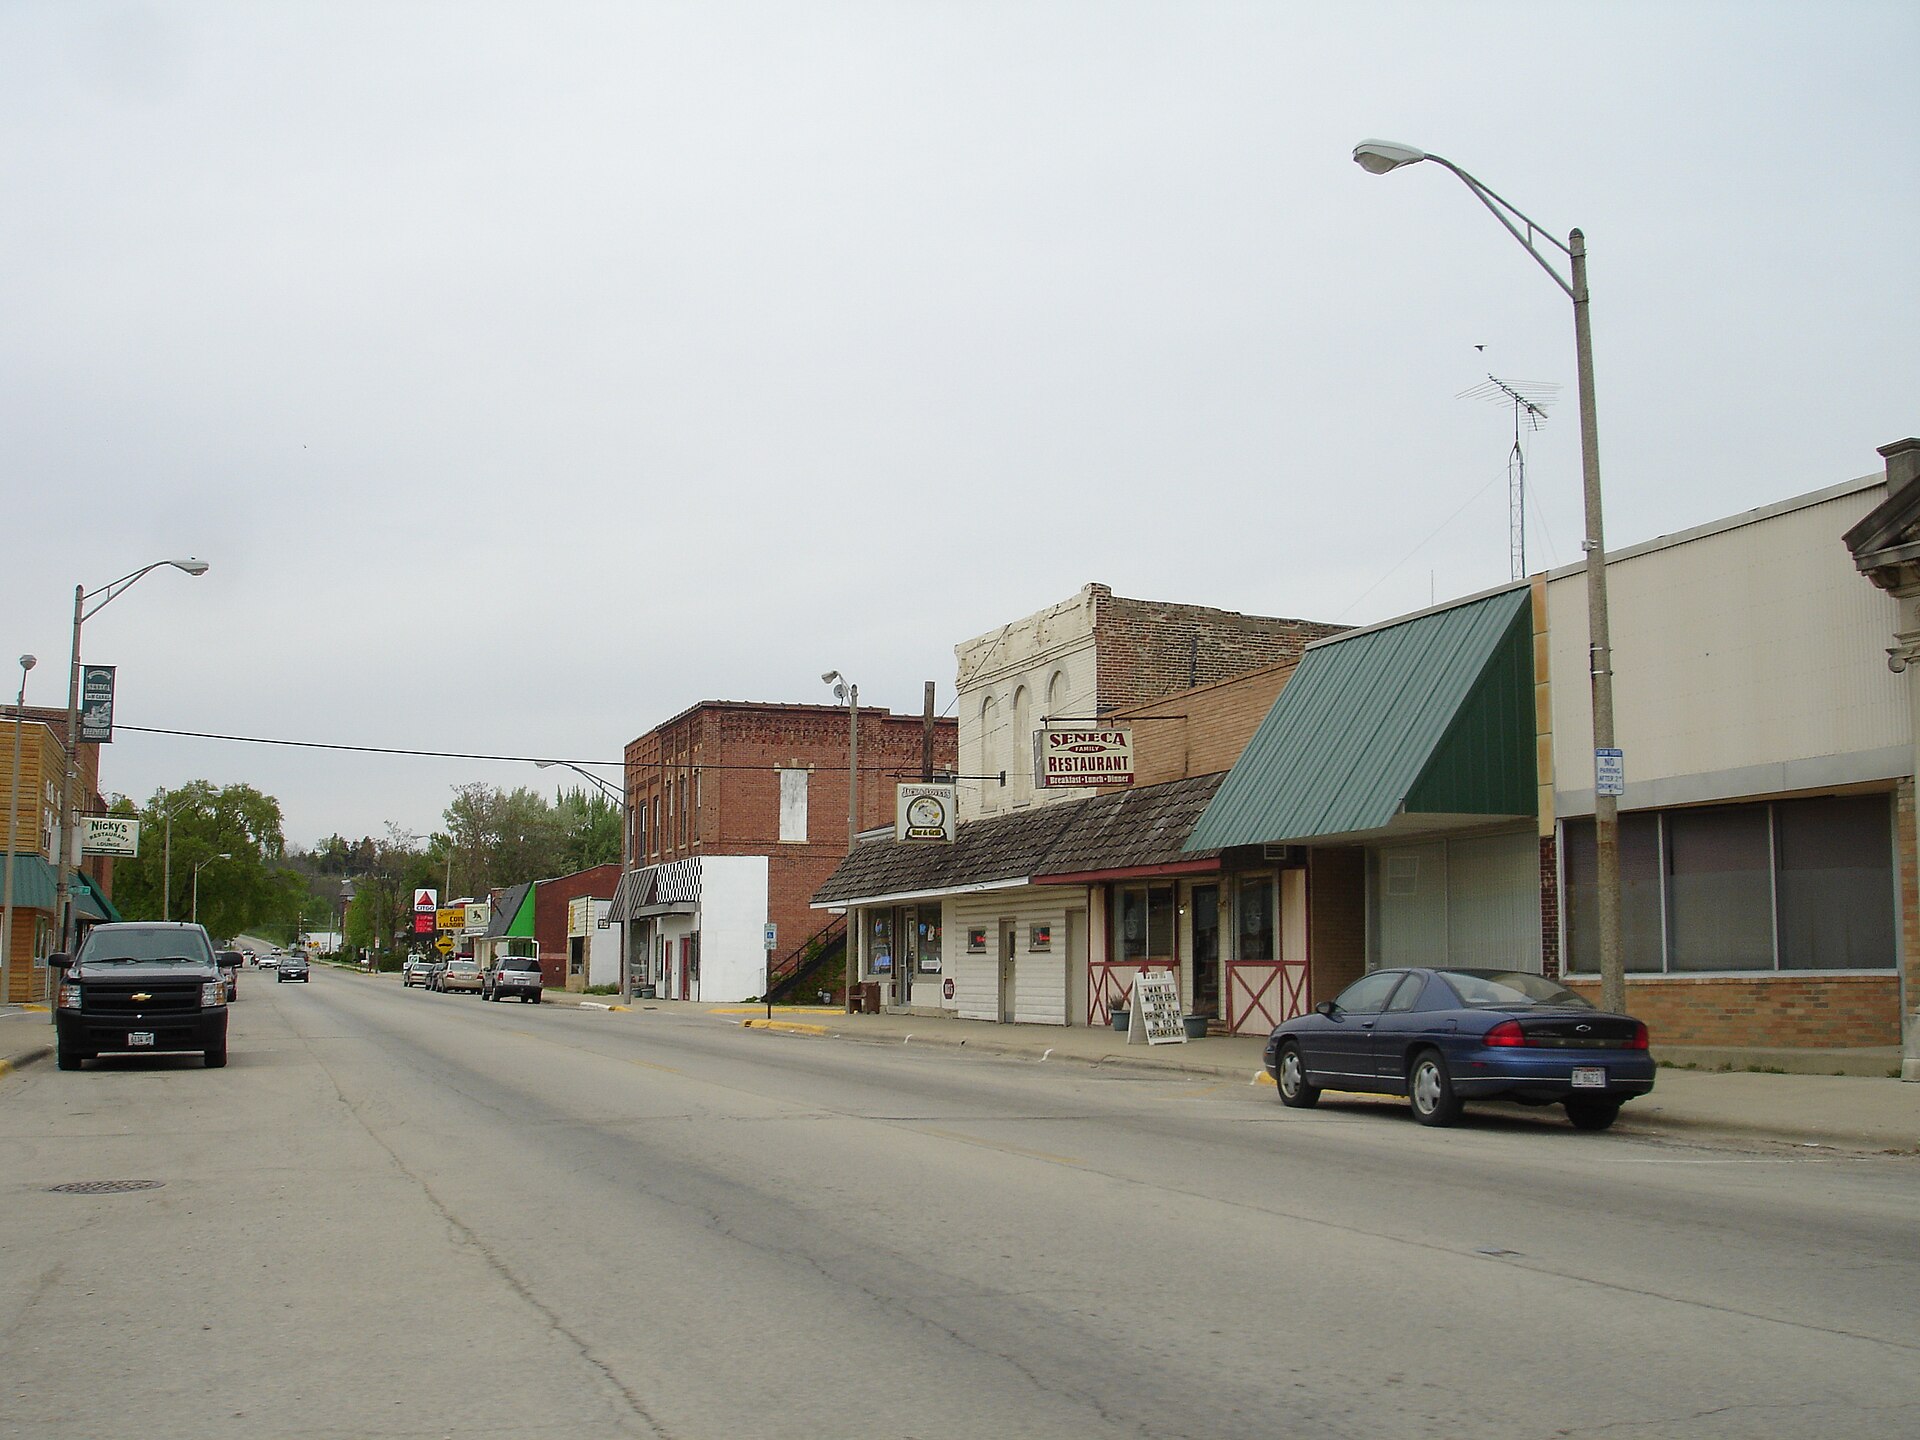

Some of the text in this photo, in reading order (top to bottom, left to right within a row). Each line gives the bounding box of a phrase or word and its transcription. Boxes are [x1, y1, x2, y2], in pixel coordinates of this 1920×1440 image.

[1049, 732, 1128, 749] SENECA
[1048, 755, 1129, 773] RESTAURANT
[1604, 758, 1615, 767] NO
[1049, 774, 1129, 785] Breakfast Lunch Dinner
[91, 820, 128, 833] Nicky's
[89, 832, 129, 842] RESTAURANT
[1147, 985, 1161, 993] MAY
[1145, 992, 1177, 1002] MOTHERS
[1153, 1002, 1166, 1011] DAY
[1144, 1010, 1180, 1020] BRING HER
[1163, 1019, 1177, 1028] FOR
[1148, 1027, 1184, 1038] BREAKFAST
